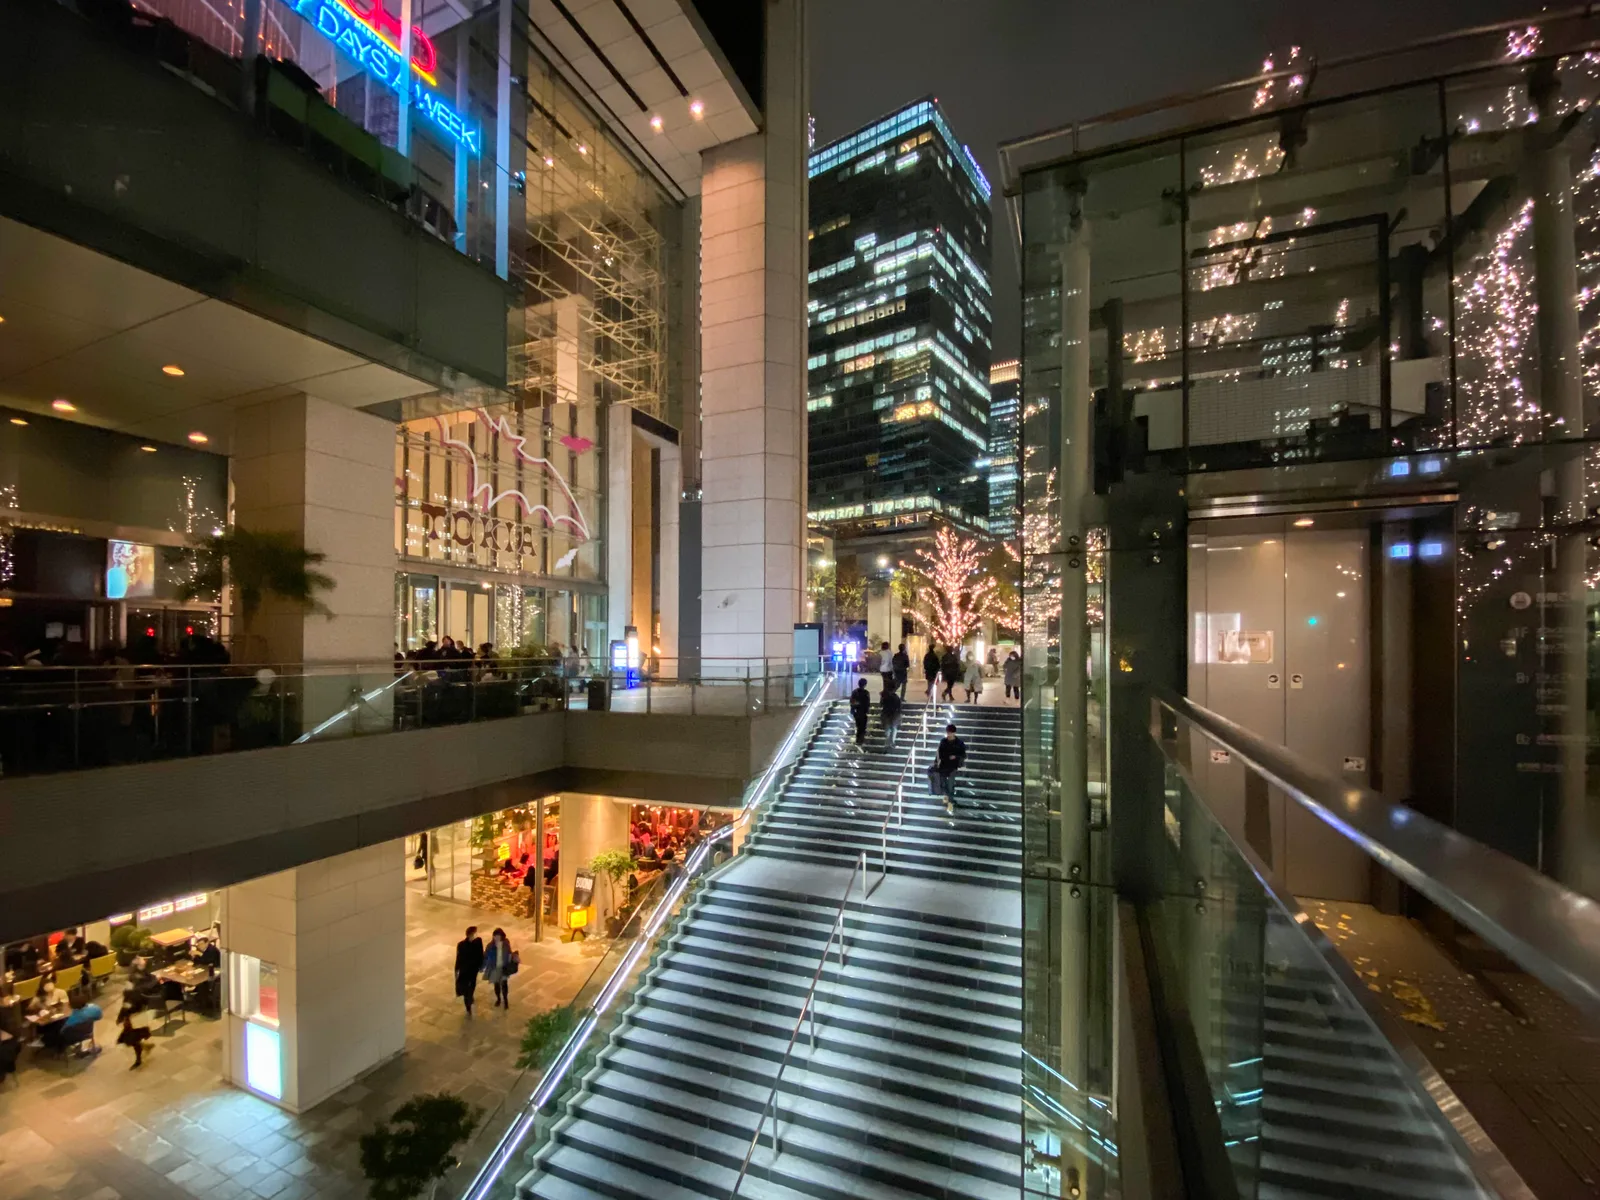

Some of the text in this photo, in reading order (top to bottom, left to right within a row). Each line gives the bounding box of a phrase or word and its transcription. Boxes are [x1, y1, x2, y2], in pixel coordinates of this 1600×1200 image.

[318, 5, 388, 79] DAYS
[415, 84, 477, 153] WEEK
[420, 502, 537, 557] TOKIA
